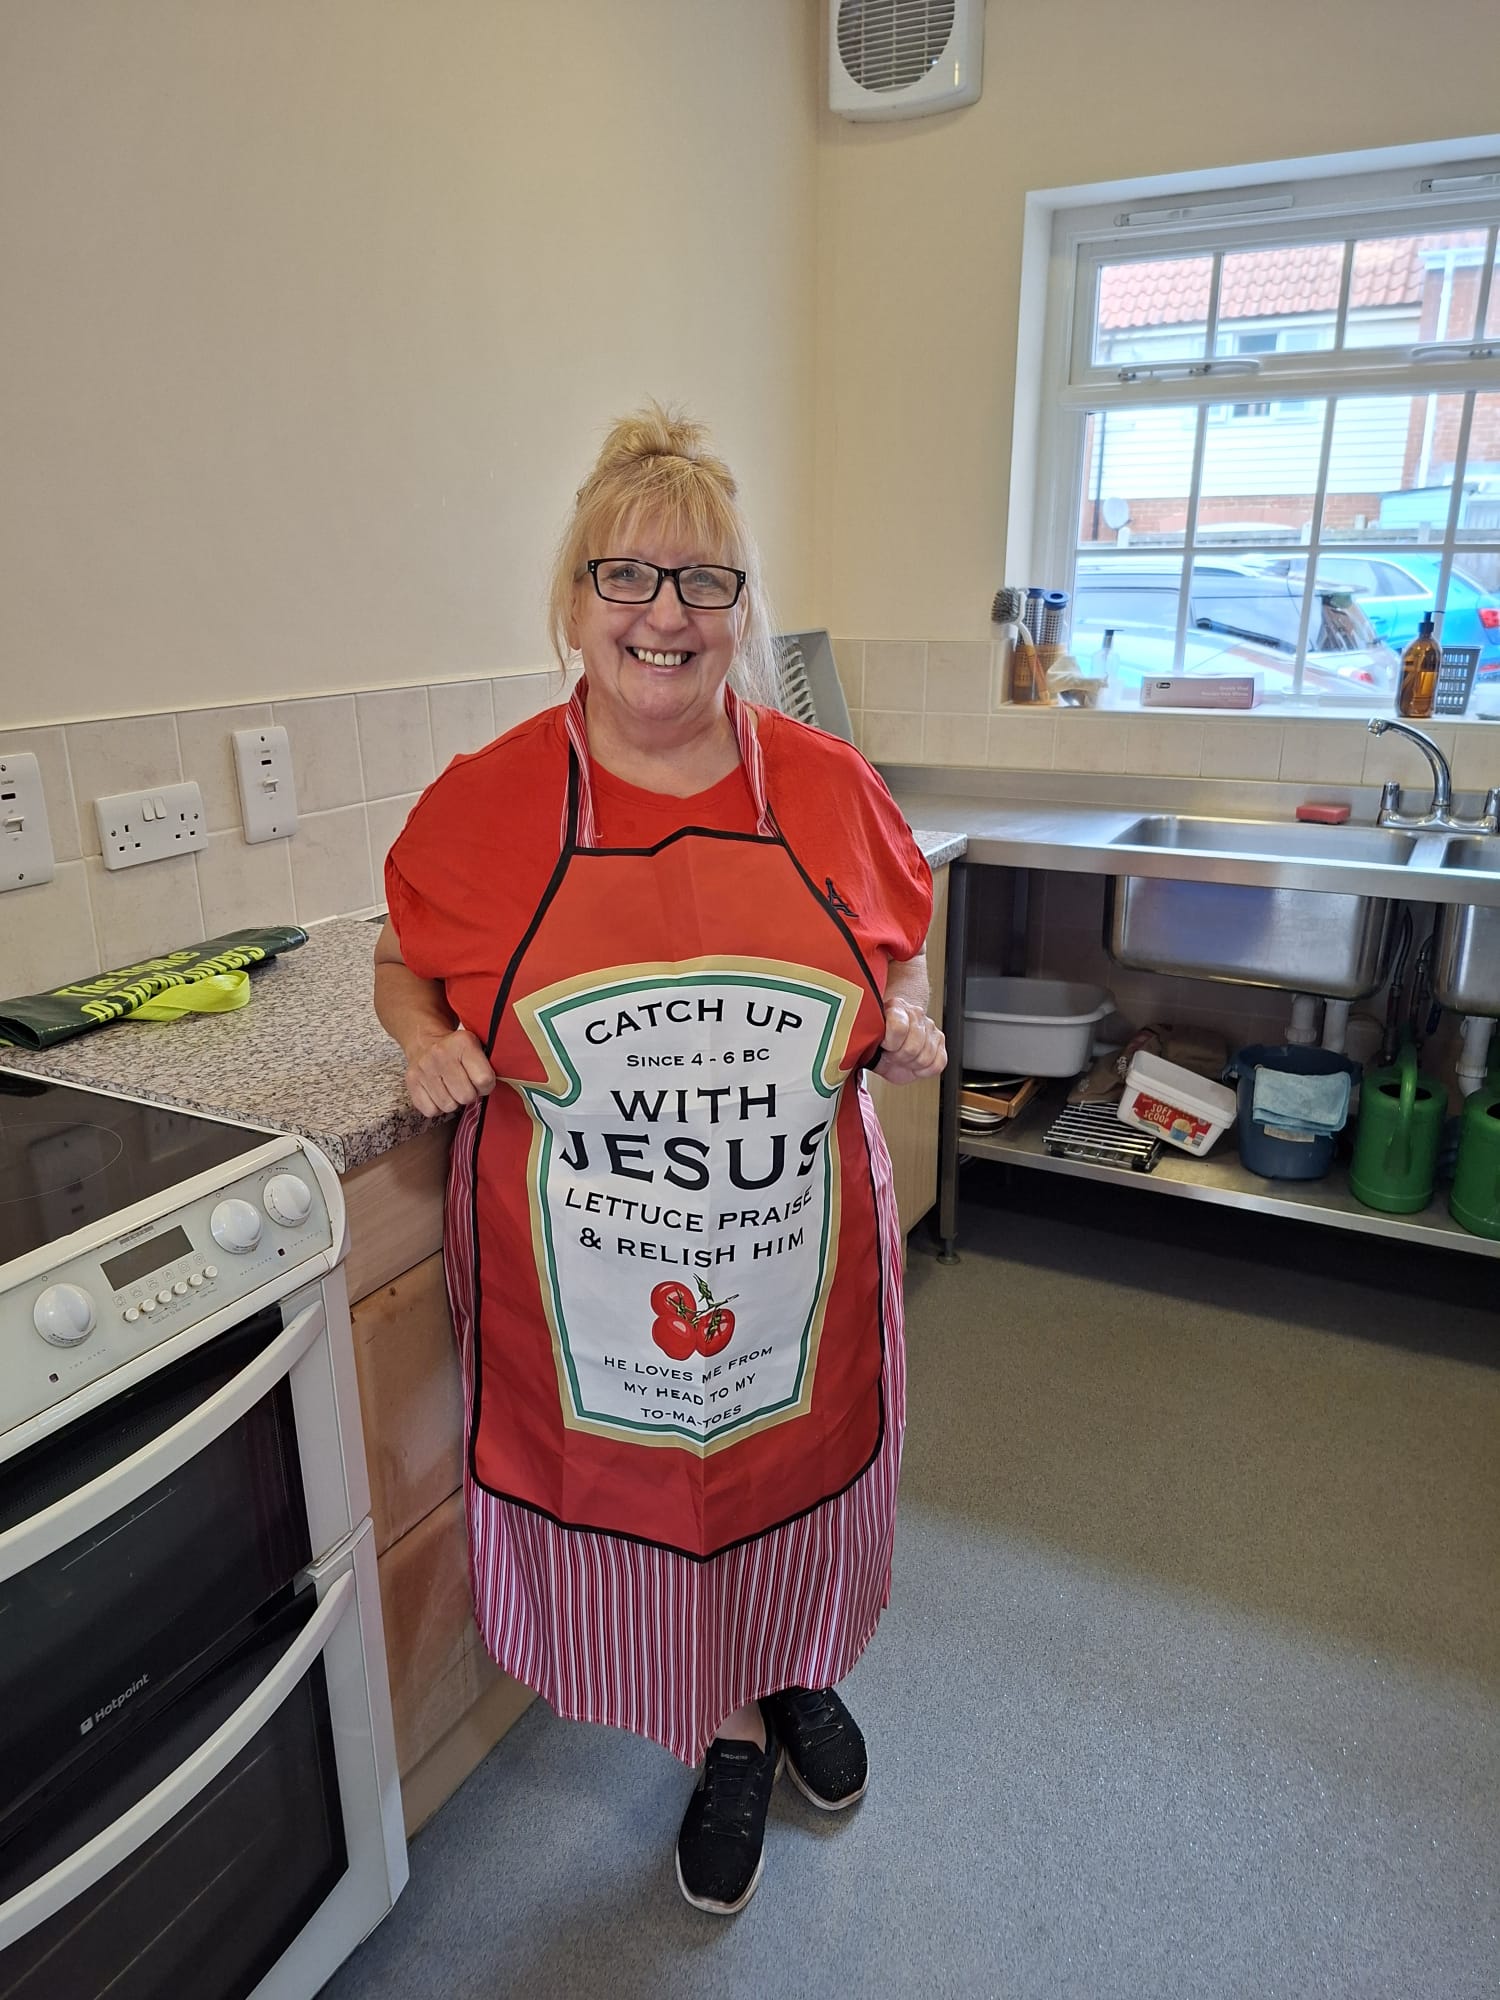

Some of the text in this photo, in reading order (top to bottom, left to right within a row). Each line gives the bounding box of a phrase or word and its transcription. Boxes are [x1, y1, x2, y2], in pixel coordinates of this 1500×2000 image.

[53, 977, 128, 997] The
[81, 1000, 123, 1023] of
[164, 946, 265, 983] lovers
[585, 998, 803, 1045] CATCH UP
[690, 1053, 703, 1065] 4
[723, 1051, 735, 1064] 6
[743, 1048, 770, 1063] BC
[611, 1083, 777, 1124] WITH
[1151, 1103, 1172, 1117] SOFT
[559, 1120, 829, 1191] JESUS
[565, 1185, 812, 1233] LETTUCE PRAISE
[579, 1227, 804, 1268] & RELISH HIM
[604, 1346, 773, 1384] HE LOVES ME FROM
[624, 1372, 756, 1406] MY HEAD TO MY
[640, 1404, 742, 1429] TO-MA-TOES
[94, 1673, 150, 1722] Hotpoint
